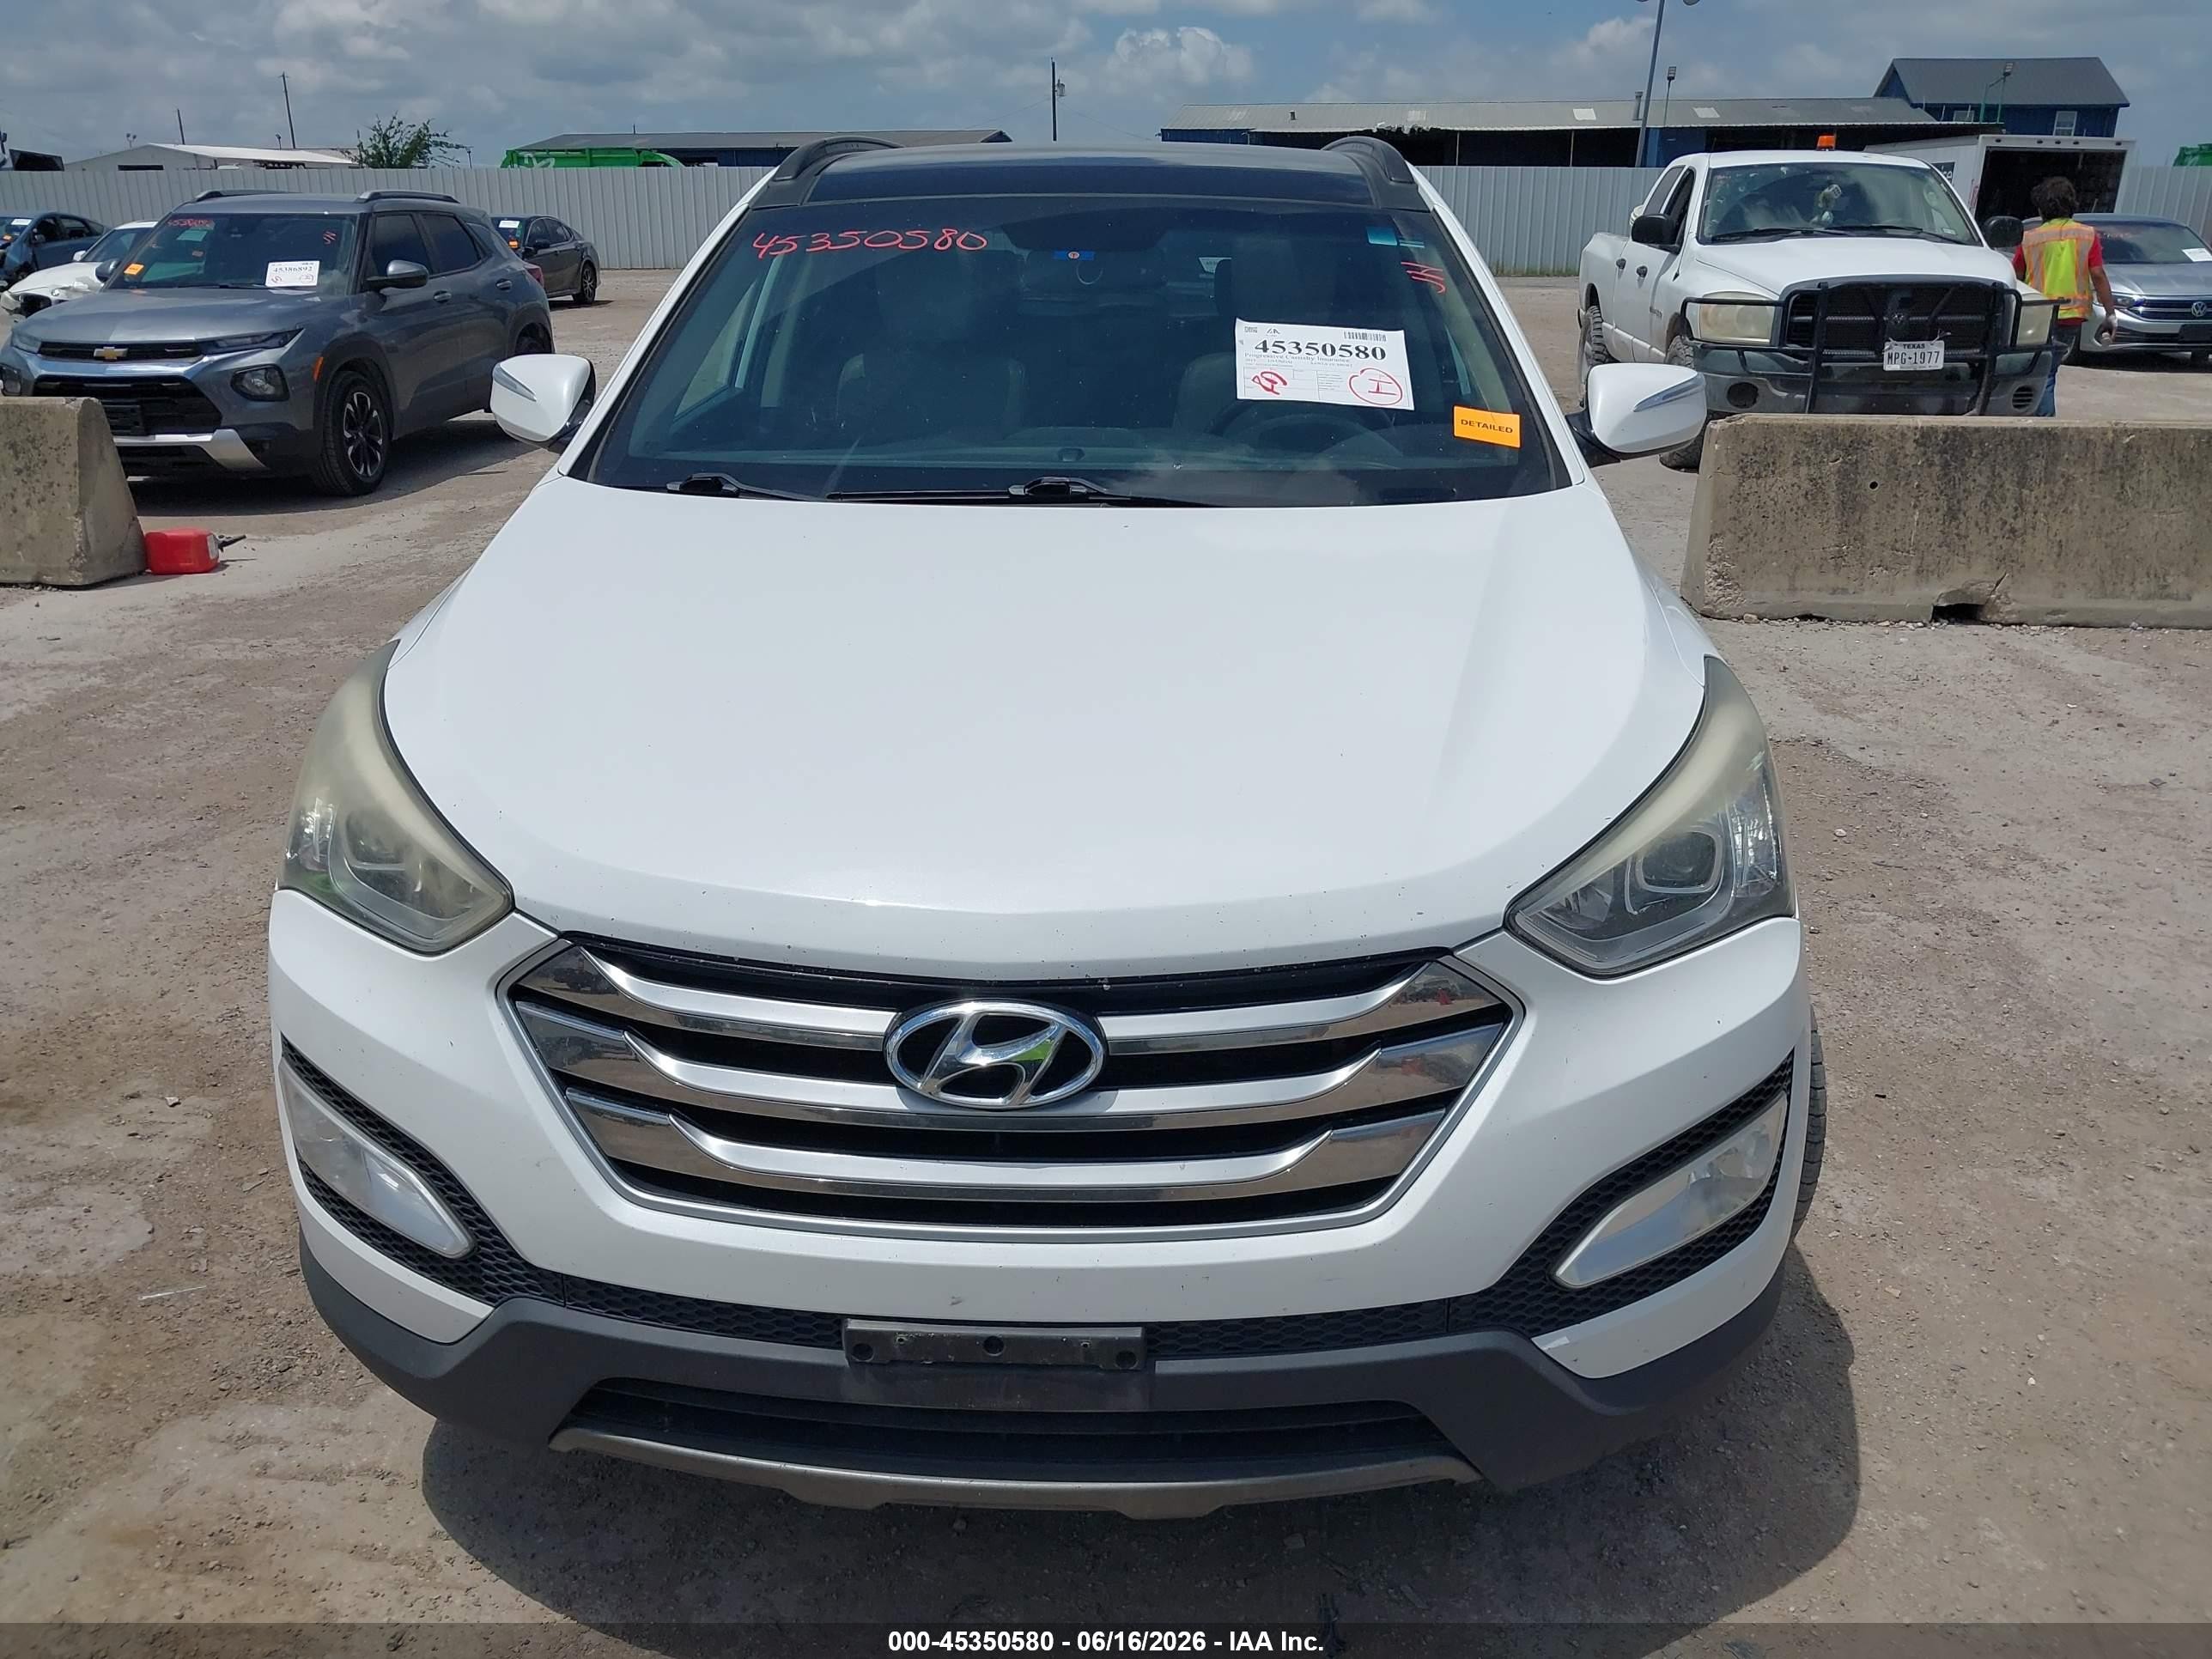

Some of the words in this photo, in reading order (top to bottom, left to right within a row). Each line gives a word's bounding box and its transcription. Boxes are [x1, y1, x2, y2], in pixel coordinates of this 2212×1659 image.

[752, 229, 987, 258] 45350580
[1255, 339, 1386, 360] 45350580
[1461, 419, 1513, 433] DETAILED
